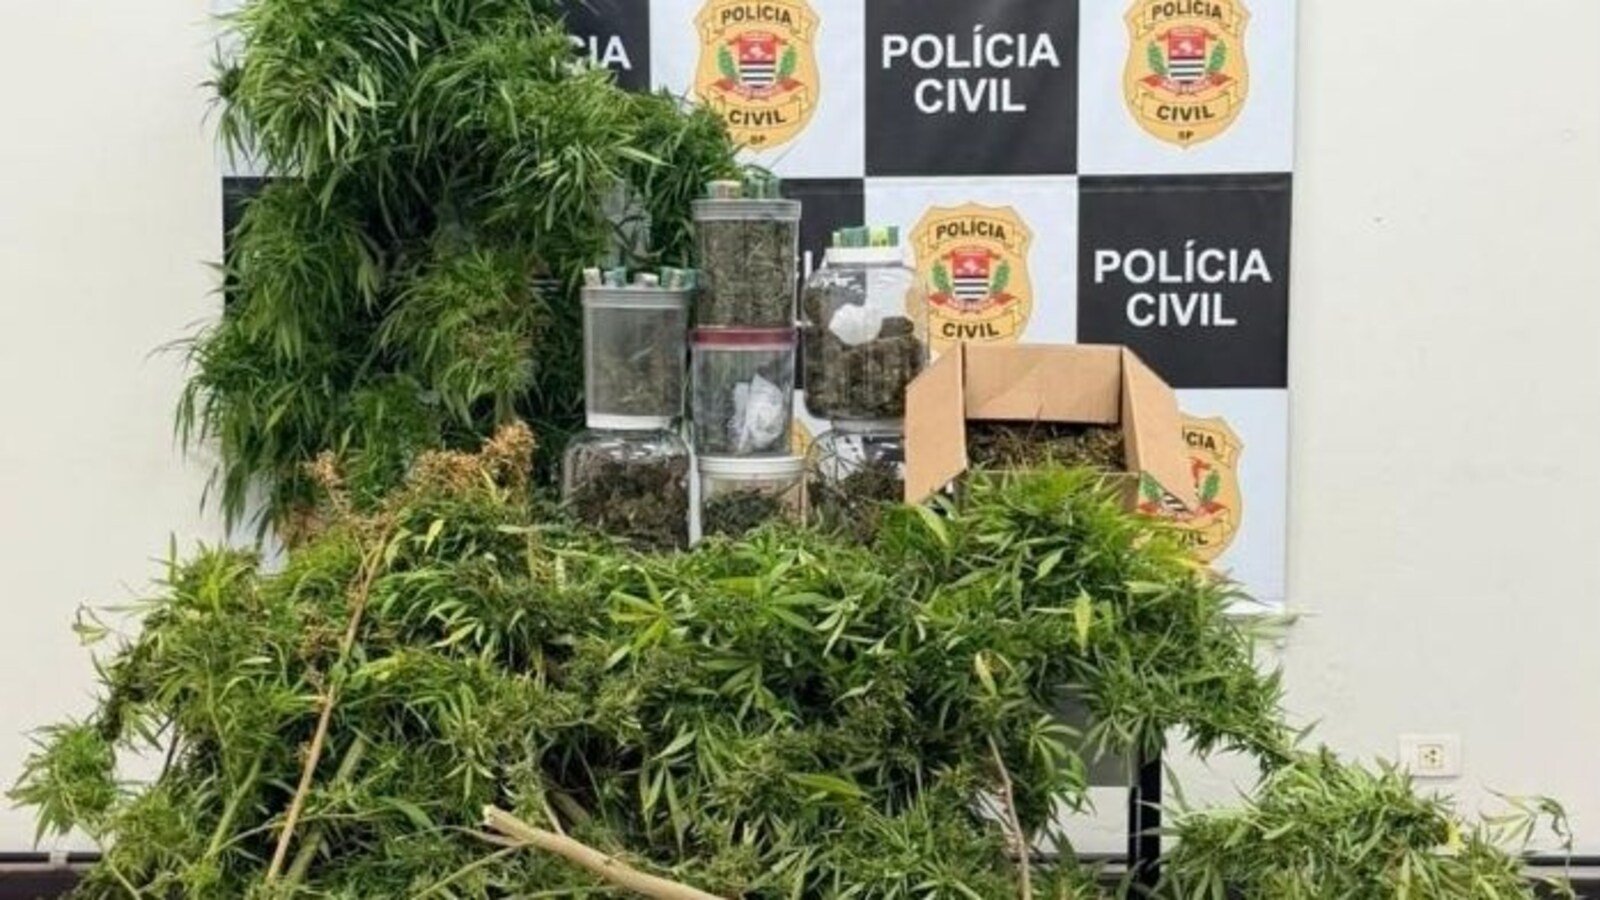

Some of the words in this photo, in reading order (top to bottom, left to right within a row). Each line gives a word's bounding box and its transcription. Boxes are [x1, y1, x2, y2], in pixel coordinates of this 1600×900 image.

[881, 26, 1060, 69] POLÍCIA
[914, 78, 1027, 113] CIVIL
[729, 109, 787, 126] CIVIL
[1156, 105, 1216, 122] CIVIL
[1094, 238, 1273, 284] POLÍCIA
[1125, 291, 1239, 328] CIVIL
[942, 322, 1000, 339] CIVIL
